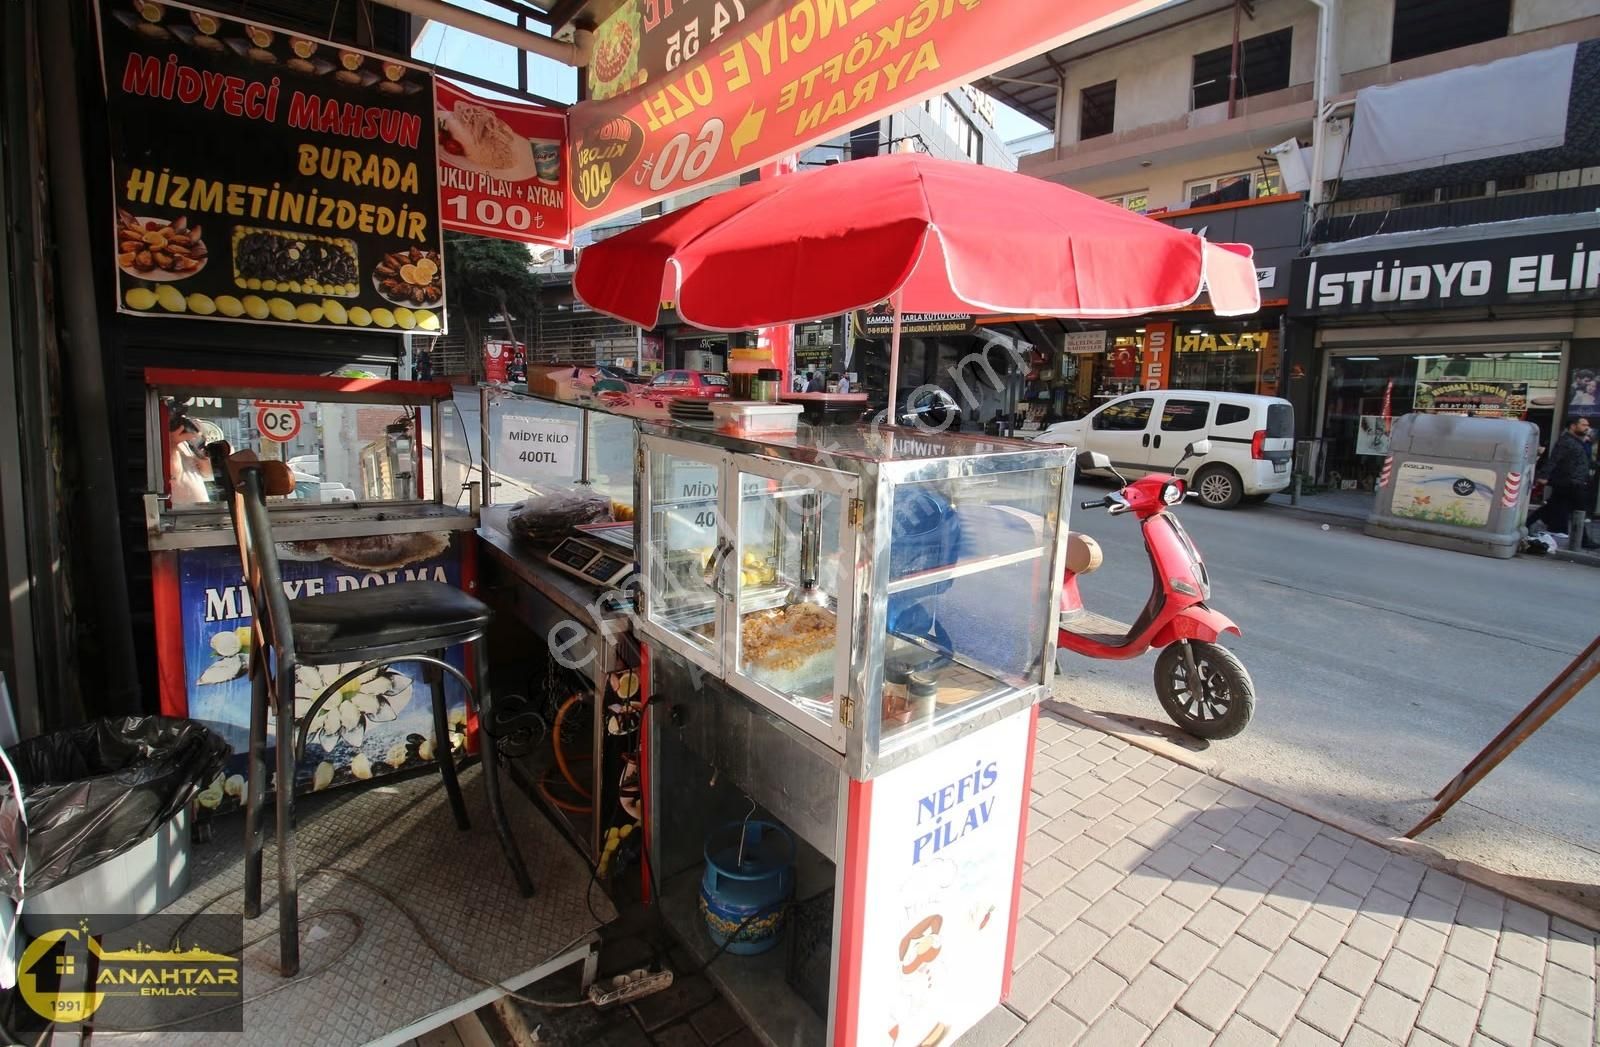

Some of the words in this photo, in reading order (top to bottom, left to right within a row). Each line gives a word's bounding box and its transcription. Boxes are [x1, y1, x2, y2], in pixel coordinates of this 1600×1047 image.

[122, 52, 281, 123] MİDYECİ
[288, 91, 422, 149] MAHSUN
[297, 143, 419, 195] BURADA
[478, 171, 513, 199] PİLAV
[526, 185, 564, 209] AYRAN
[126, 166, 428, 244] HİZMETİNİZDEDİR
[1318, 259, 1492, 307] STÜDYO
[509, 429, 544, 443] MİDYE
[546, 432, 569, 444] KİLO
[518, 450, 558, 463] 400TL
[915, 759, 999, 827] NEFİS
[911, 796, 997, 867] PİLAV
